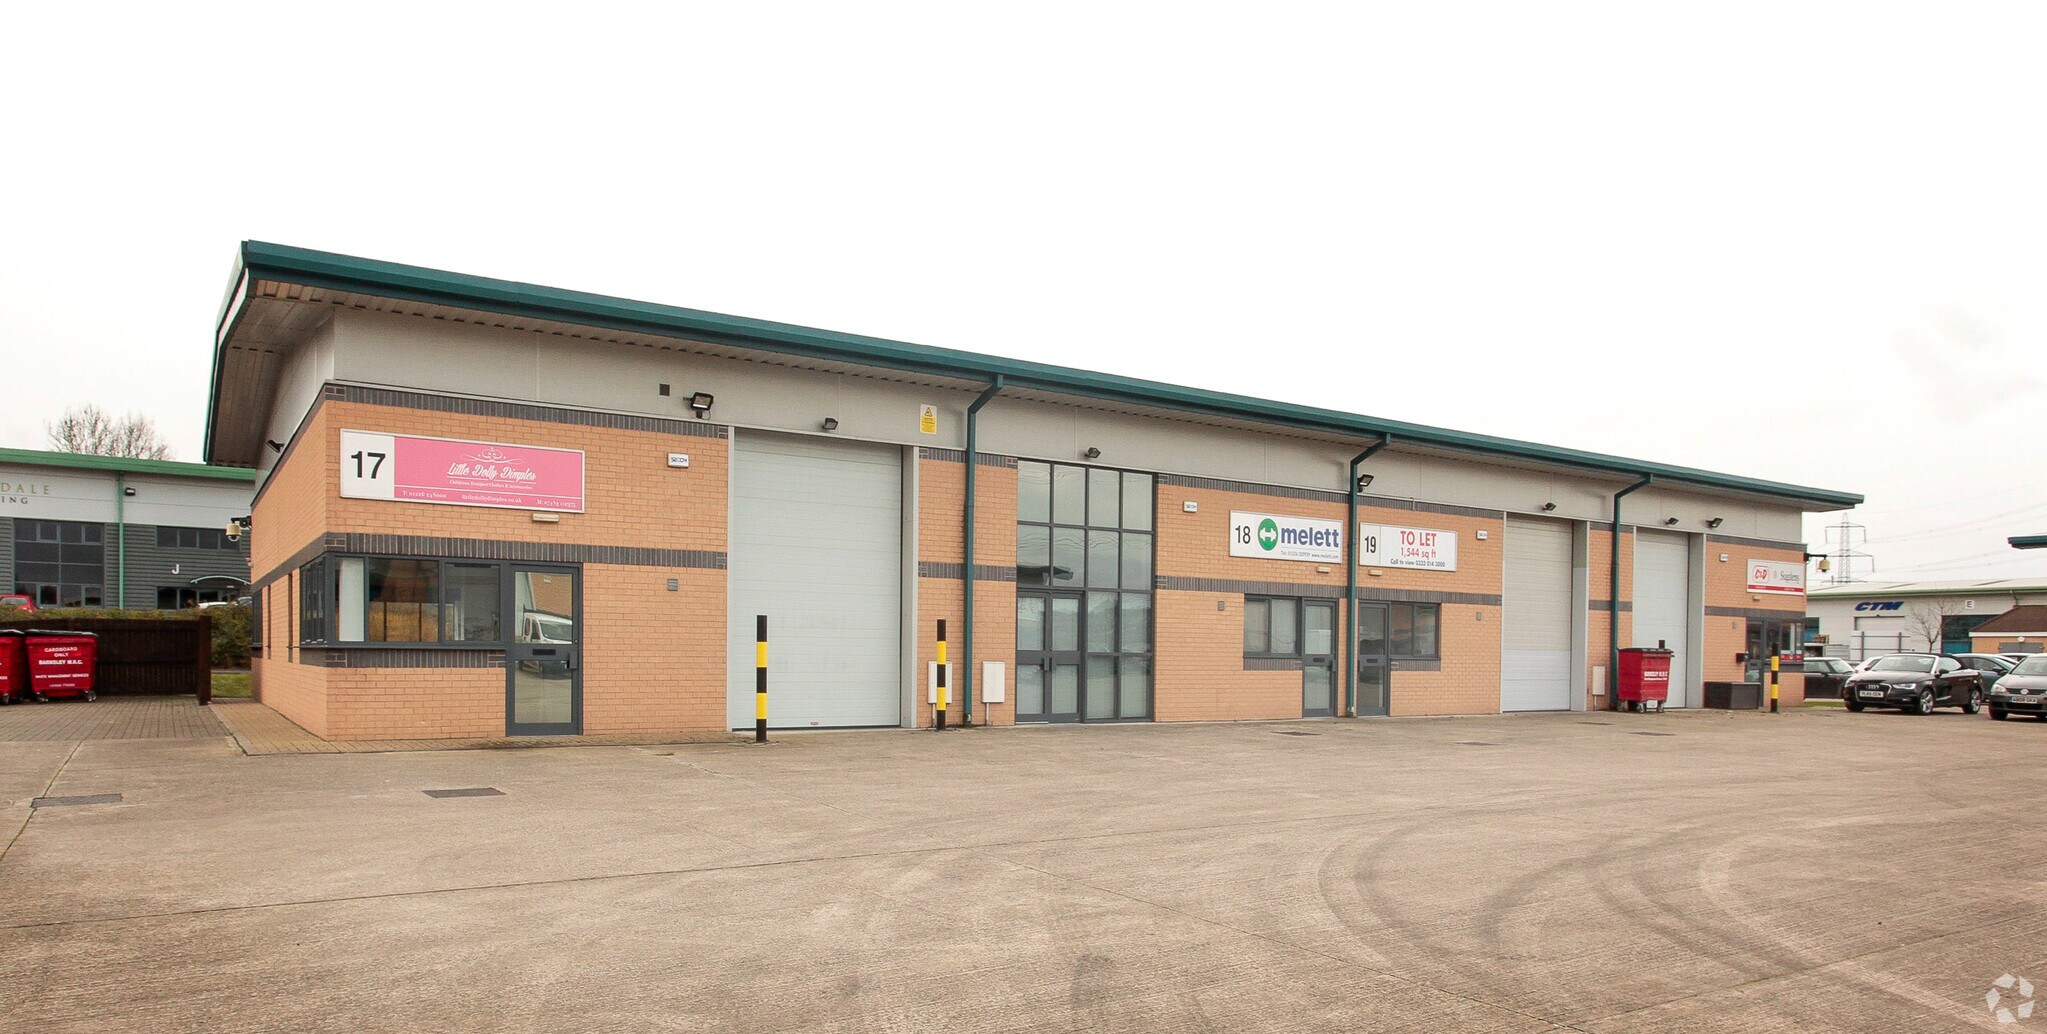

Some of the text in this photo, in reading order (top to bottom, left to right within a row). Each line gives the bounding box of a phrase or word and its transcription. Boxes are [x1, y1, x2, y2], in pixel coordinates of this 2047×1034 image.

[350, 450, 386, 479] 17
[447, 463, 536, 482] Little Dolly Dimples
[1, 482, 50, 494] DALE
[2, 496, 28, 504] ING
[1235, 525, 1251, 544] 18
[1281, 527, 1339, 548] melett
[1400, 531, 1436, 547] TO LET
[1364, 536, 1376, 553] 19
[1401, 548, 1436, 560] 1,544 sq ft
[172, 564, 179, 574] J
[1855, 601, 1904, 611] CTM
